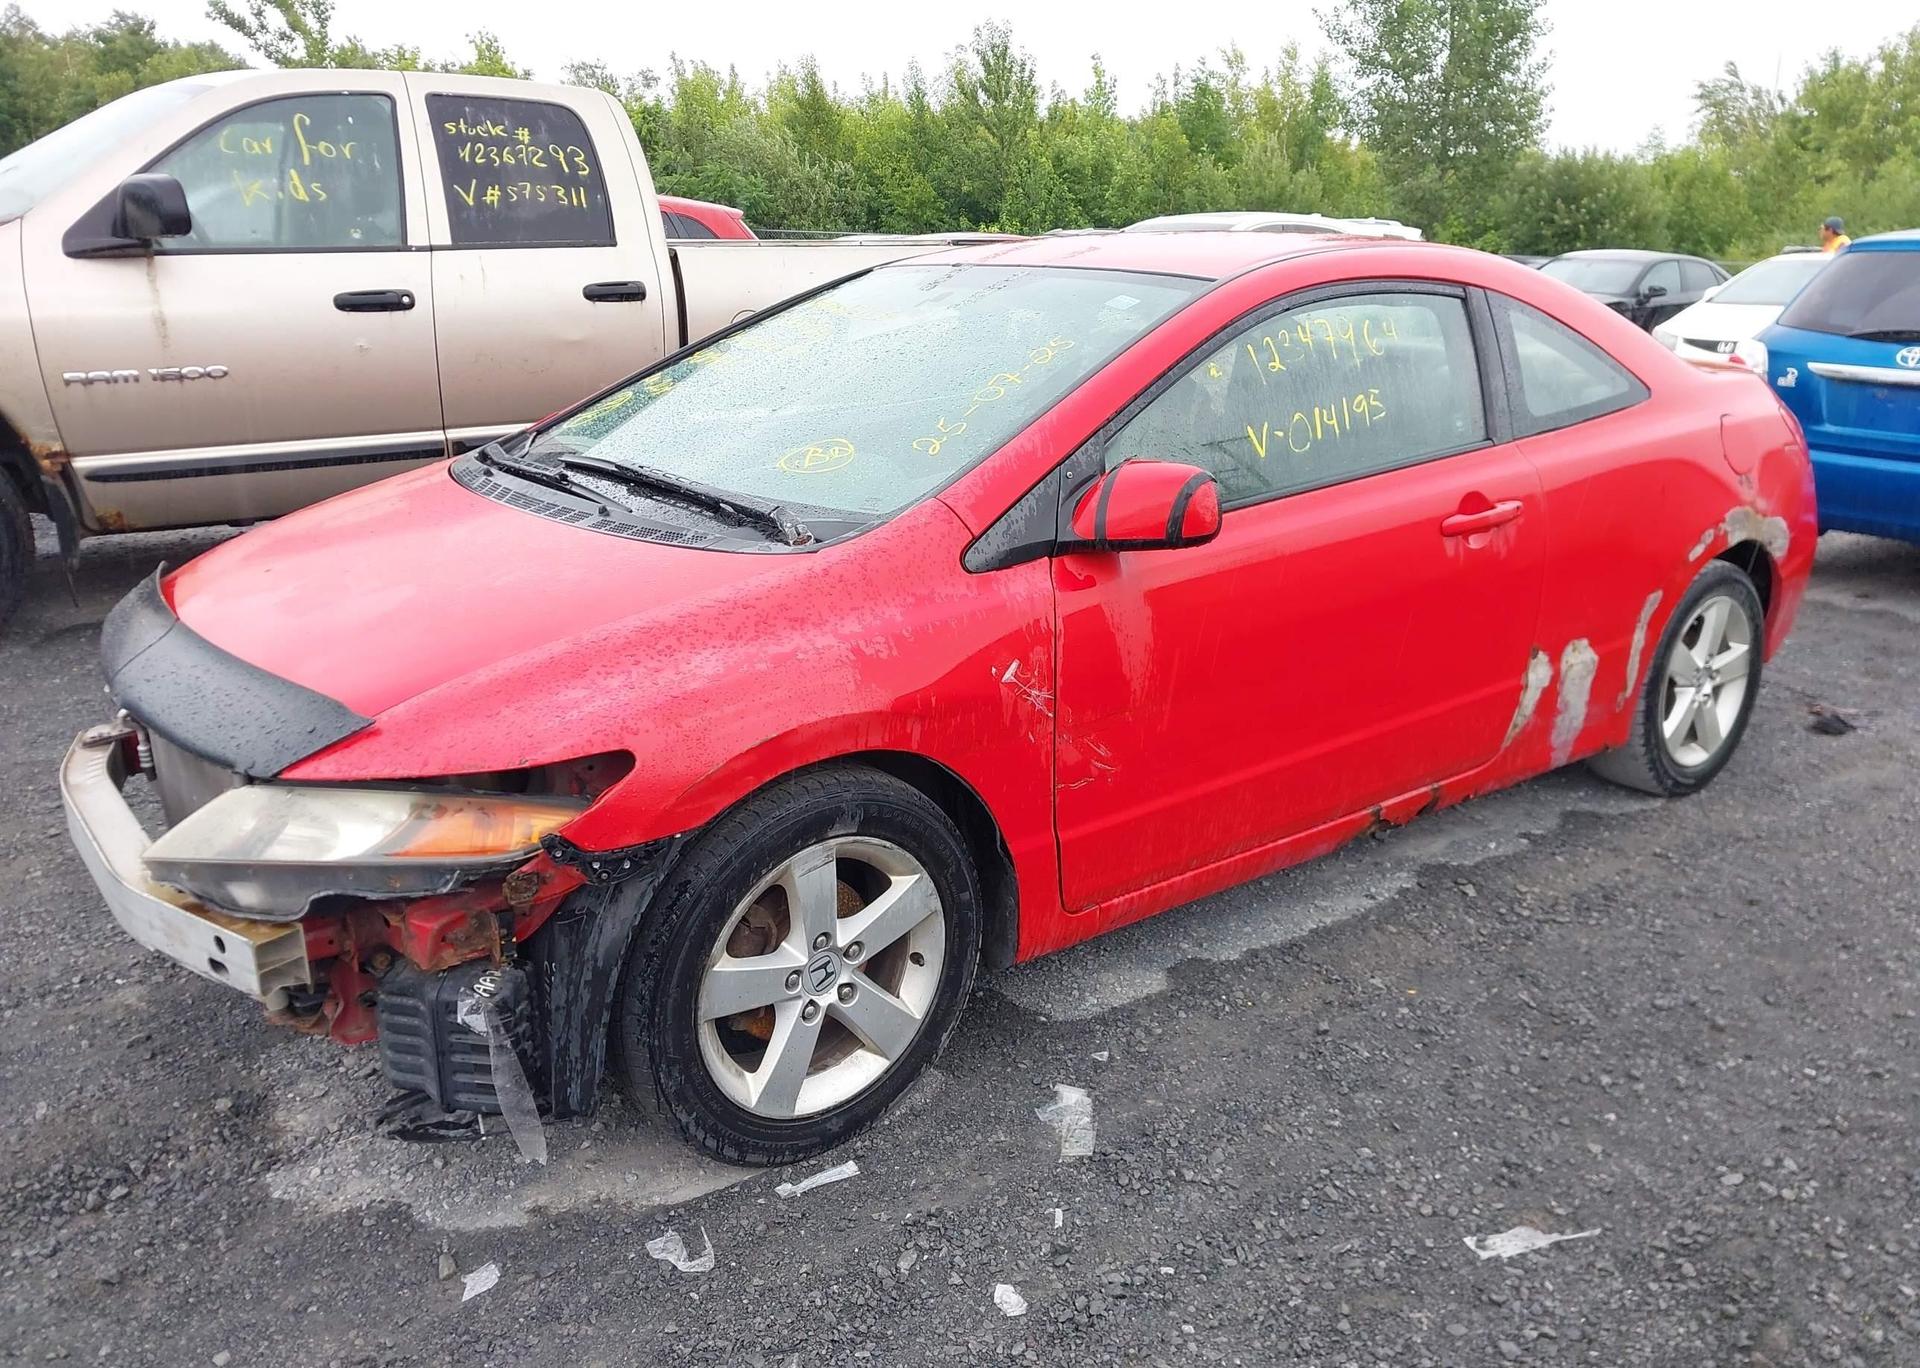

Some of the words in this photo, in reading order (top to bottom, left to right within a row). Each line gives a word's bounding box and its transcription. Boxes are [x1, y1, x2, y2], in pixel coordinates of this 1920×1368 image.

[293, 112, 357, 166] for
[511, 126, 532, 145] #
[62, 368, 140, 387] RAM
